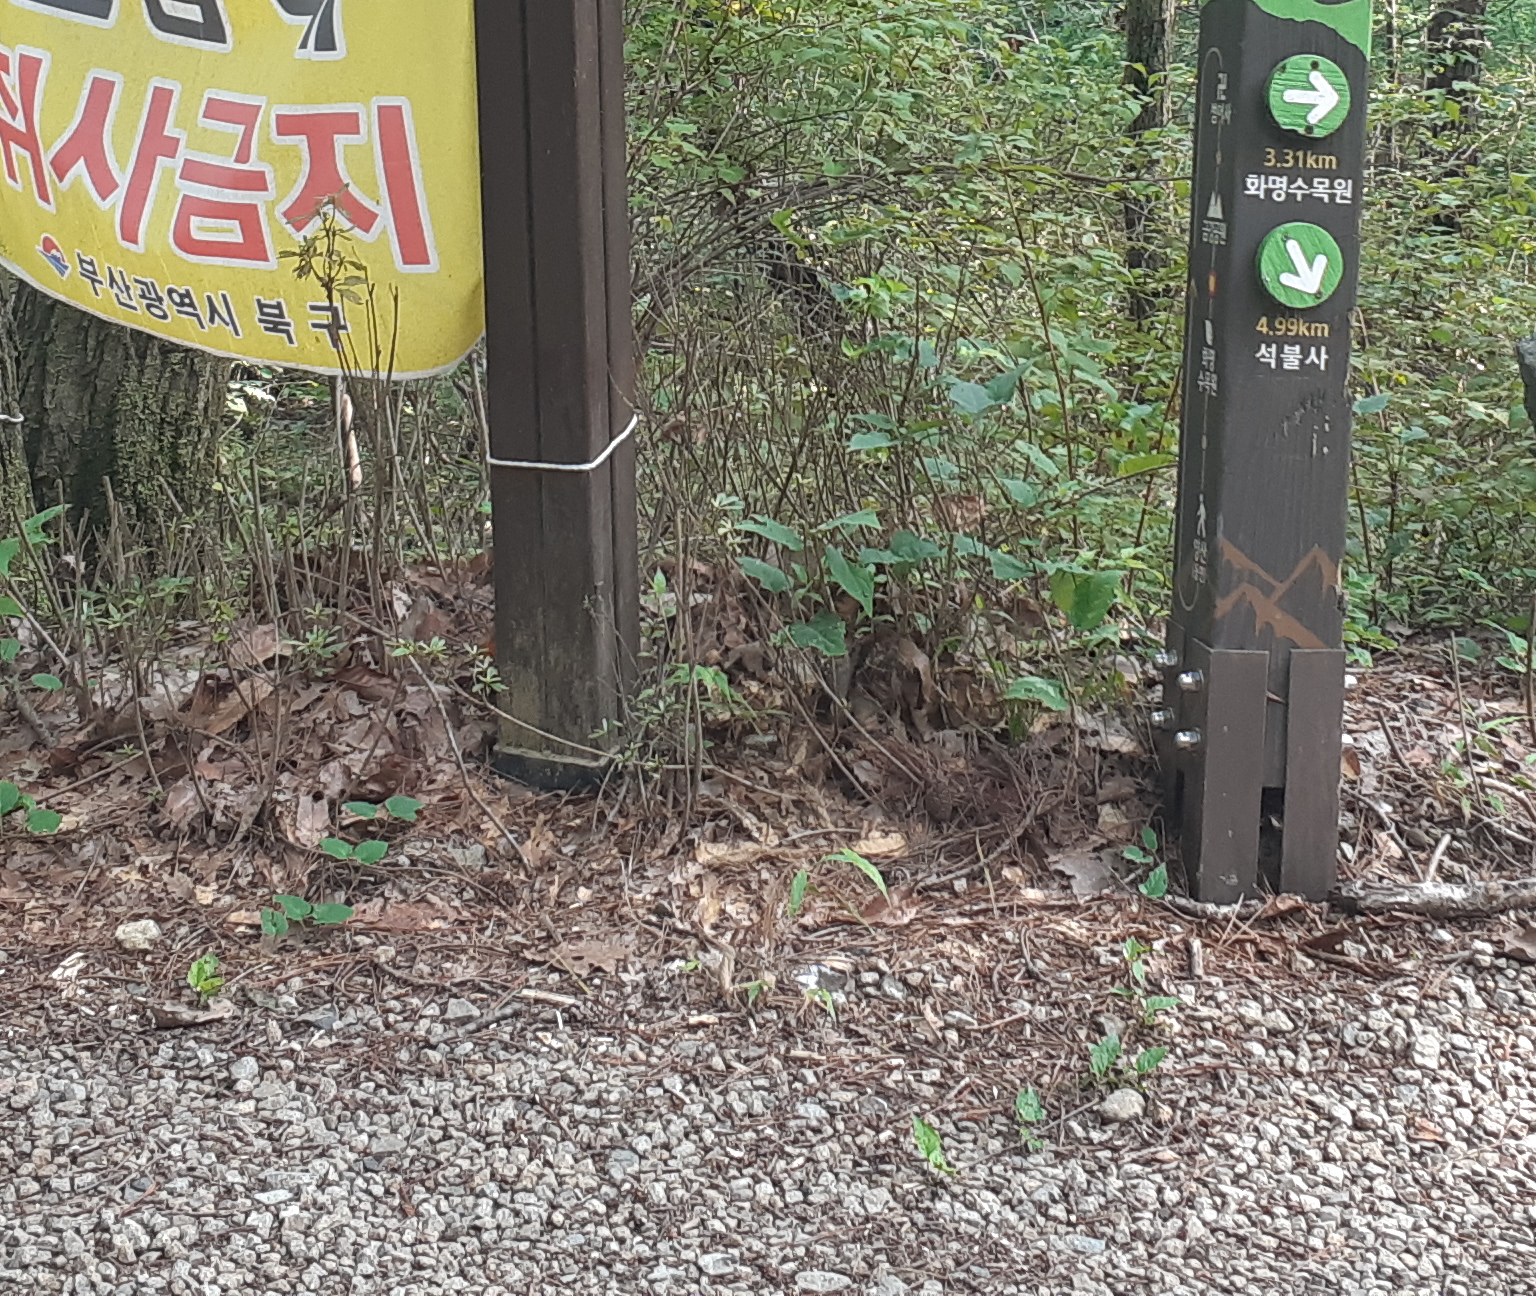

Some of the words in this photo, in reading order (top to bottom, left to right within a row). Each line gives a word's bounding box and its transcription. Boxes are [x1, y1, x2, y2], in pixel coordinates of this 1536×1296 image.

[1263, 147, 1338, 170] 3.31km
[1243, 173, 1353, 205] 화명수목원
[76, 251, 241, 337] 부산광역시
[1255, 317, 1330, 339] 4.99km
[1254, 342, 1329, 372] 석불사
